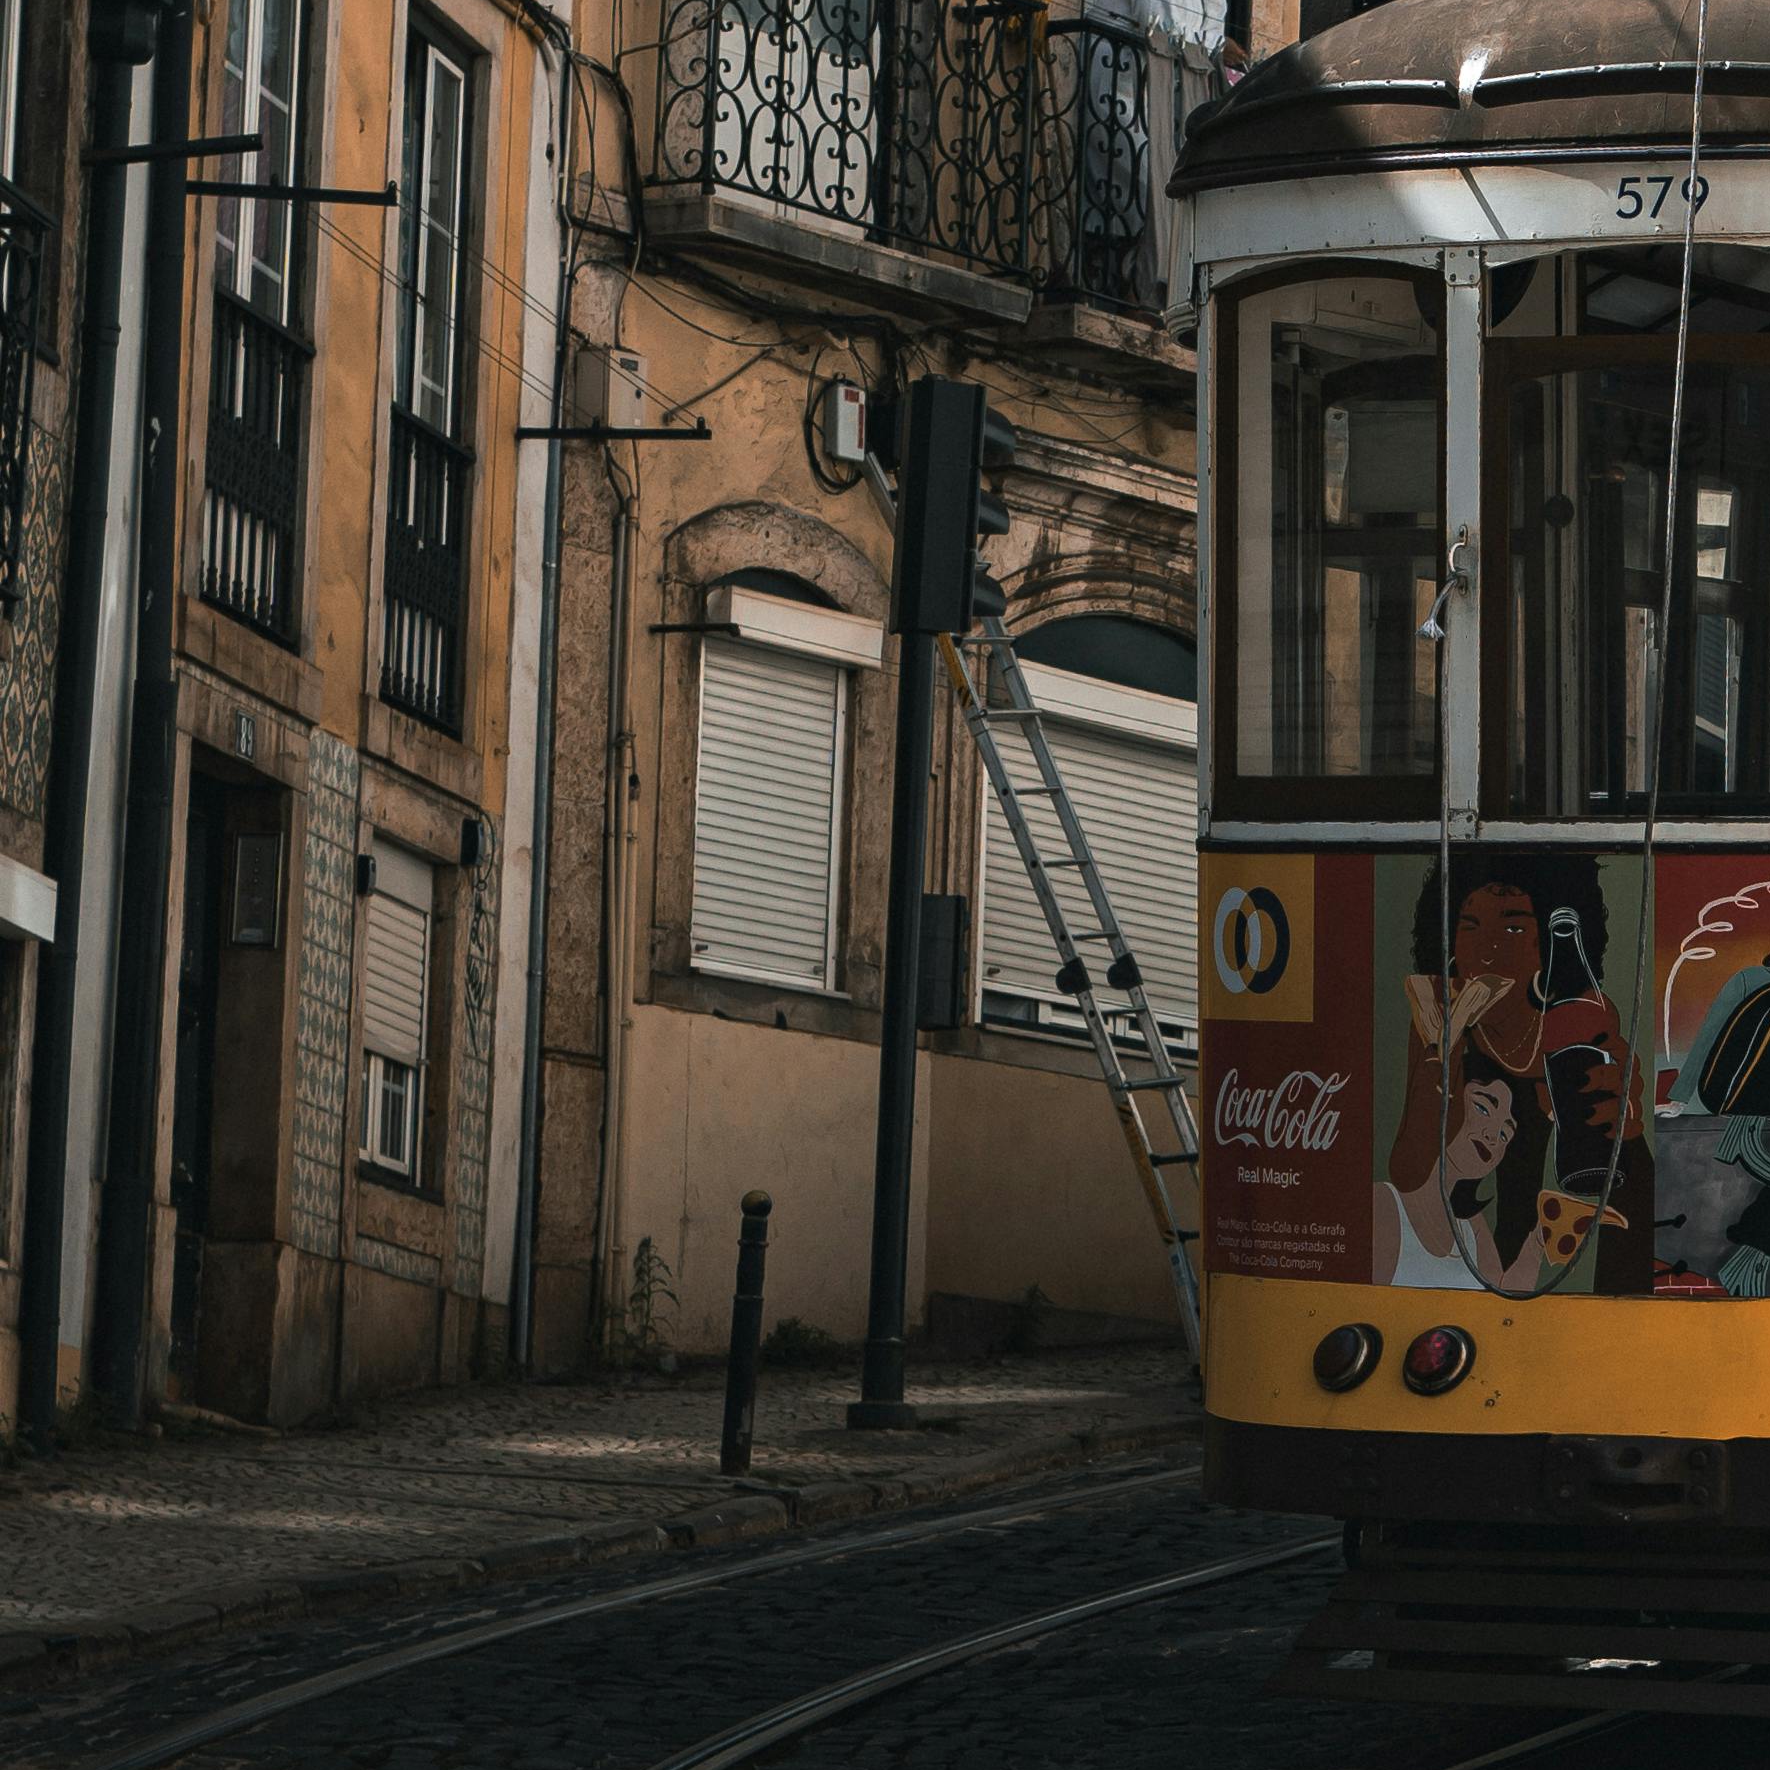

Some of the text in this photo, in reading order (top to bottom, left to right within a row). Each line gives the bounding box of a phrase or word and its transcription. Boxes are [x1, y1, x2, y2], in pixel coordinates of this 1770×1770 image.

[1615, 175, 1710, 219] 579
[1215, 1068, 1351, 1150] Coca-Cola
[1238, 1166, 1260, 1183] Real
[1251, 1219, 1292, 1234] Coca-Cola
[1310, 1222, 1345, 1236] Garrafa
[1254, 1239, 1281, 1250] marcas
[1283, 1241, 1330, 1253] registadas
[1333, 1242, 1346, 1253] de
